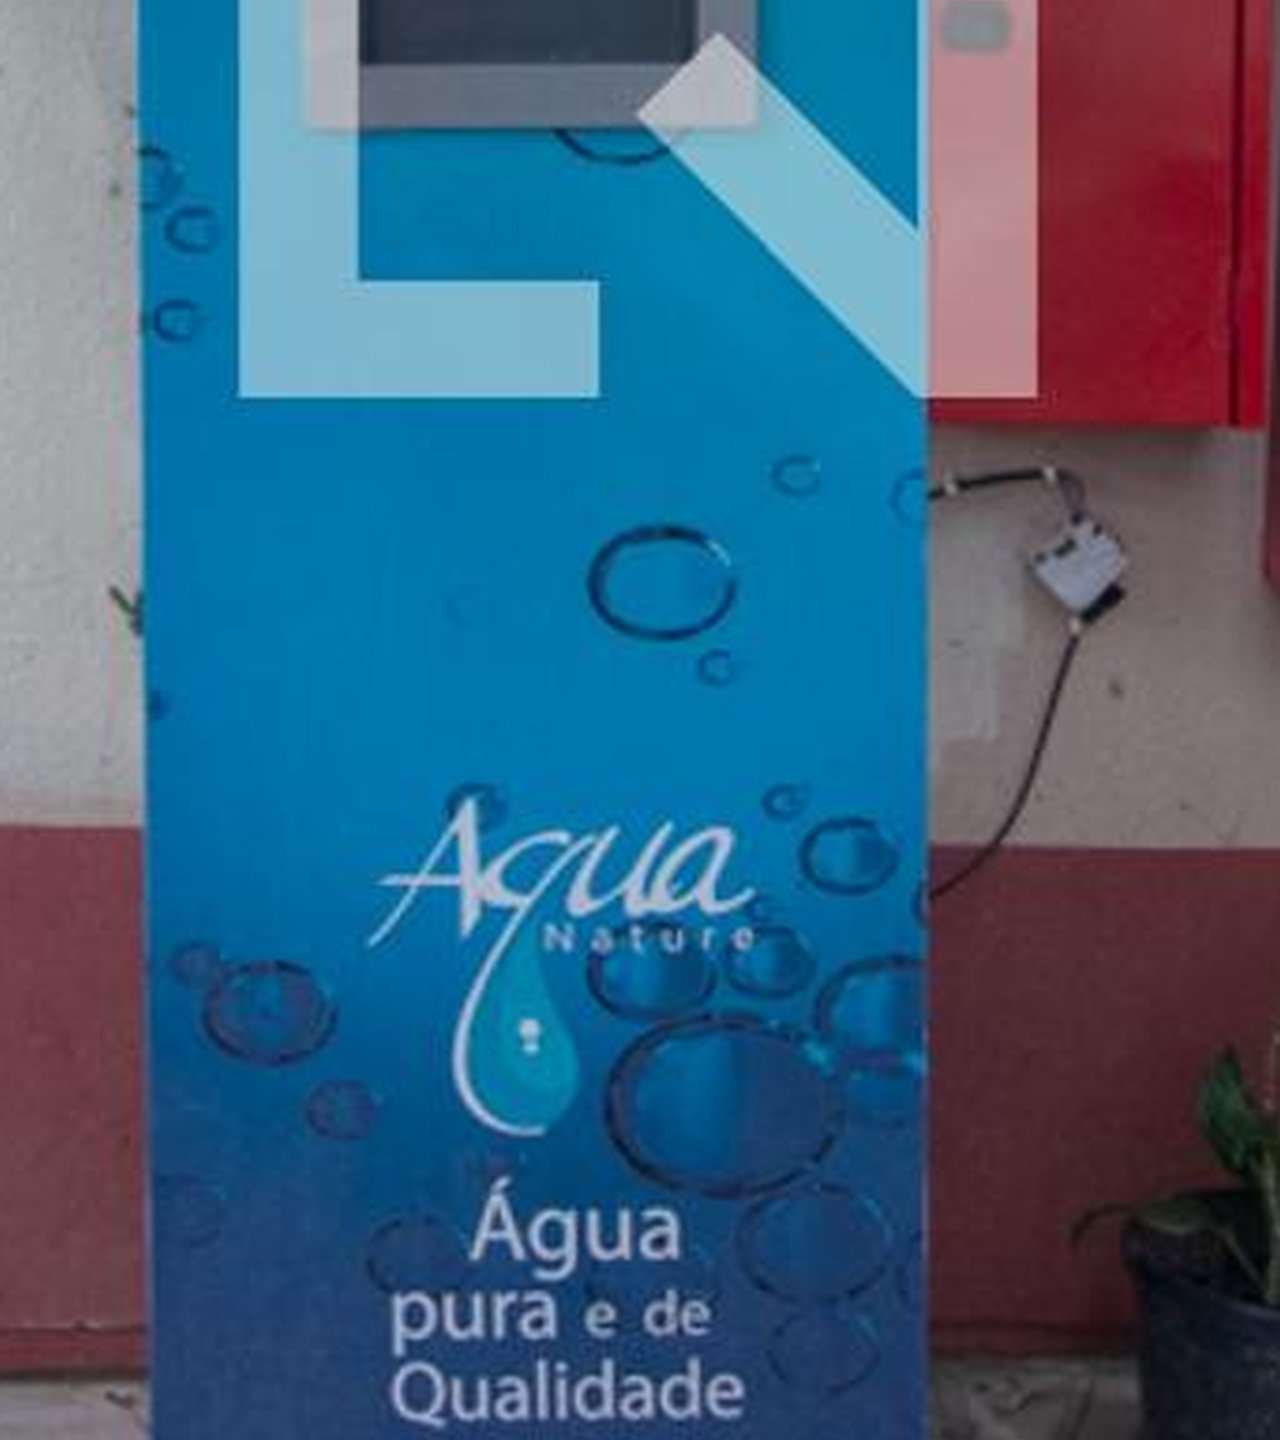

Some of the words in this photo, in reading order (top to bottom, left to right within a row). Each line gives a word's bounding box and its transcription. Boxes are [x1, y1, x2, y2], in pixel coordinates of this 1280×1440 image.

[543, 924, 756, 954] Nature
[468, 1175, 683, 1282] Água
[391, 1290, 557, 1357] pura
[583, 1300, 617, 1338] e
[642, 1288, 712, 1337] de
[391, 1355, 746, 1428] Qualidade
